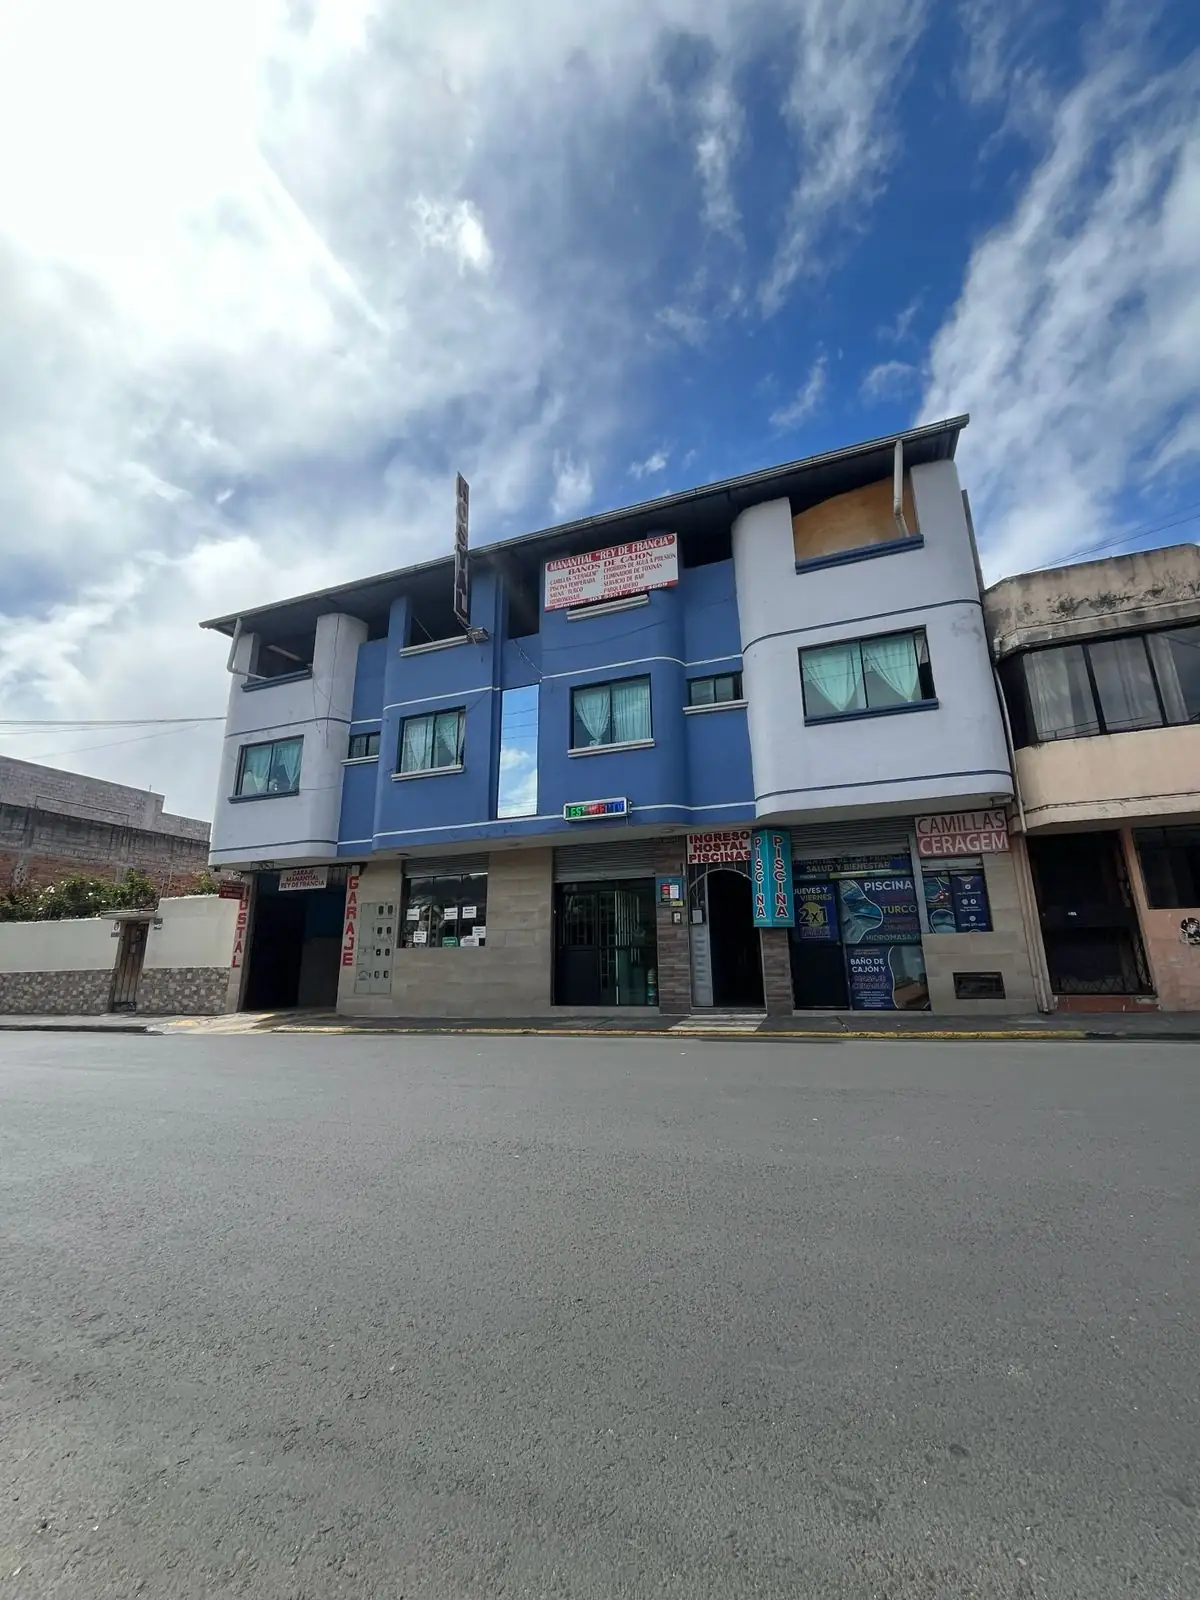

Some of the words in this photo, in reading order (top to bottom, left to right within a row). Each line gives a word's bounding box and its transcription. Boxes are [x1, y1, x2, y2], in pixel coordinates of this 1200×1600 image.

[549, 553, 593, 571] MANANTIAL
[618, 545, 629, 555] DE
[604, 559, 615, 567] DE
[918, 811, 1004, 834] CAMILLAS
[690, 831, 750, 844] INGRESO
[920, 831, 1009, 855] CERAGEM
[693, 841, 748, 853] HOSTAL
[689, 851, 751, 862] PISCINAS
[806, 865, 833, 873] SALUD
[836, 864, 842, 872] Y
[844, 862, 890, 871] BIENESTAR
[754, 836, 766, 918] PISCINA
[773, 835, 789, 918] PISCINA
[793, 887, 821, 895] JUEVES
[864, 881, 913, 892] PISCINA
[800, 893, 832, 901] VIERNES
[882, 904, 917, 914] TURCO
[342, 876, 359, 966] GARAJE
[850, 957, 872, 965] BAÑO
[852, 965, 879, 973] CAJÓN
